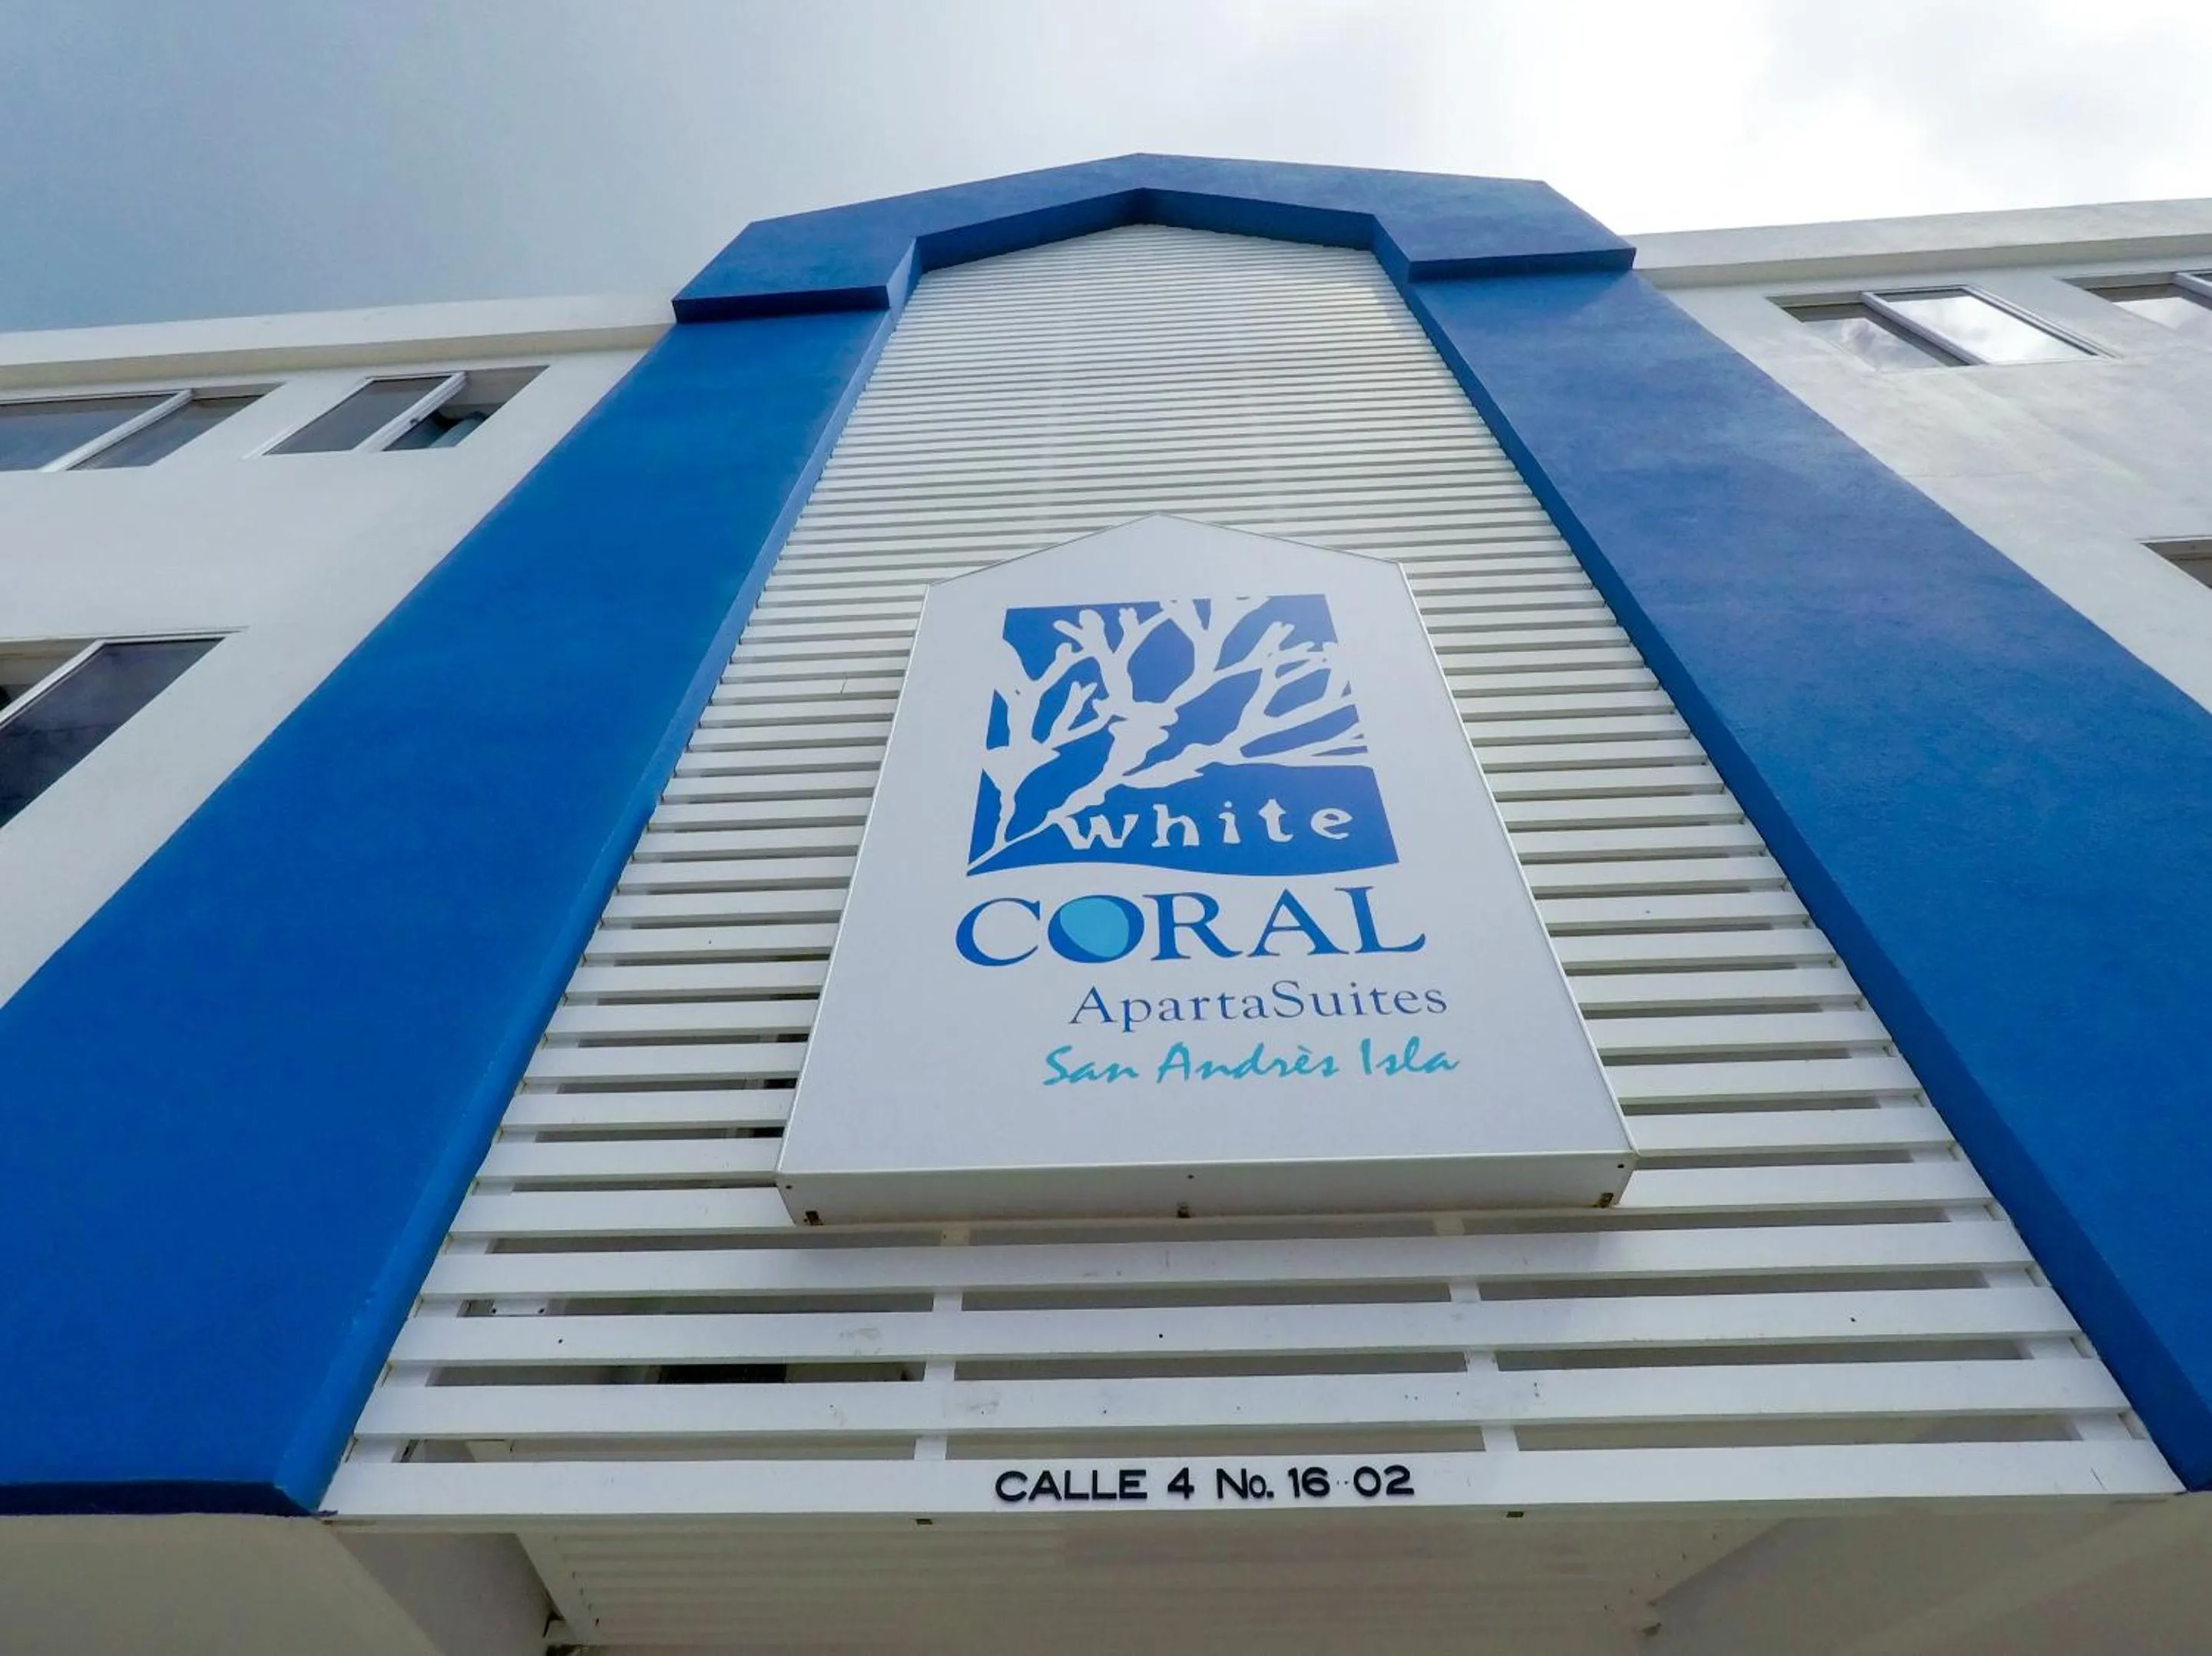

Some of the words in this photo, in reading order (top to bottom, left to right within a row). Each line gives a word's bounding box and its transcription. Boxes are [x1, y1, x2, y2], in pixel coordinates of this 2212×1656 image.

[1058, 798, 1353, 850] white
[955, 886, 1426, 967] CORAL
[1068, 979, 1448, 1033] ApartaSuites
[1042, 1045, 1139, 1086] San
[1359, 1035, 1460, 1076] Isla
[995, 1467, 1148, 1502] CALLE
[1167, 1466, 1194, 1499] 4
[1216, 1467, 1275, 1499] No.
